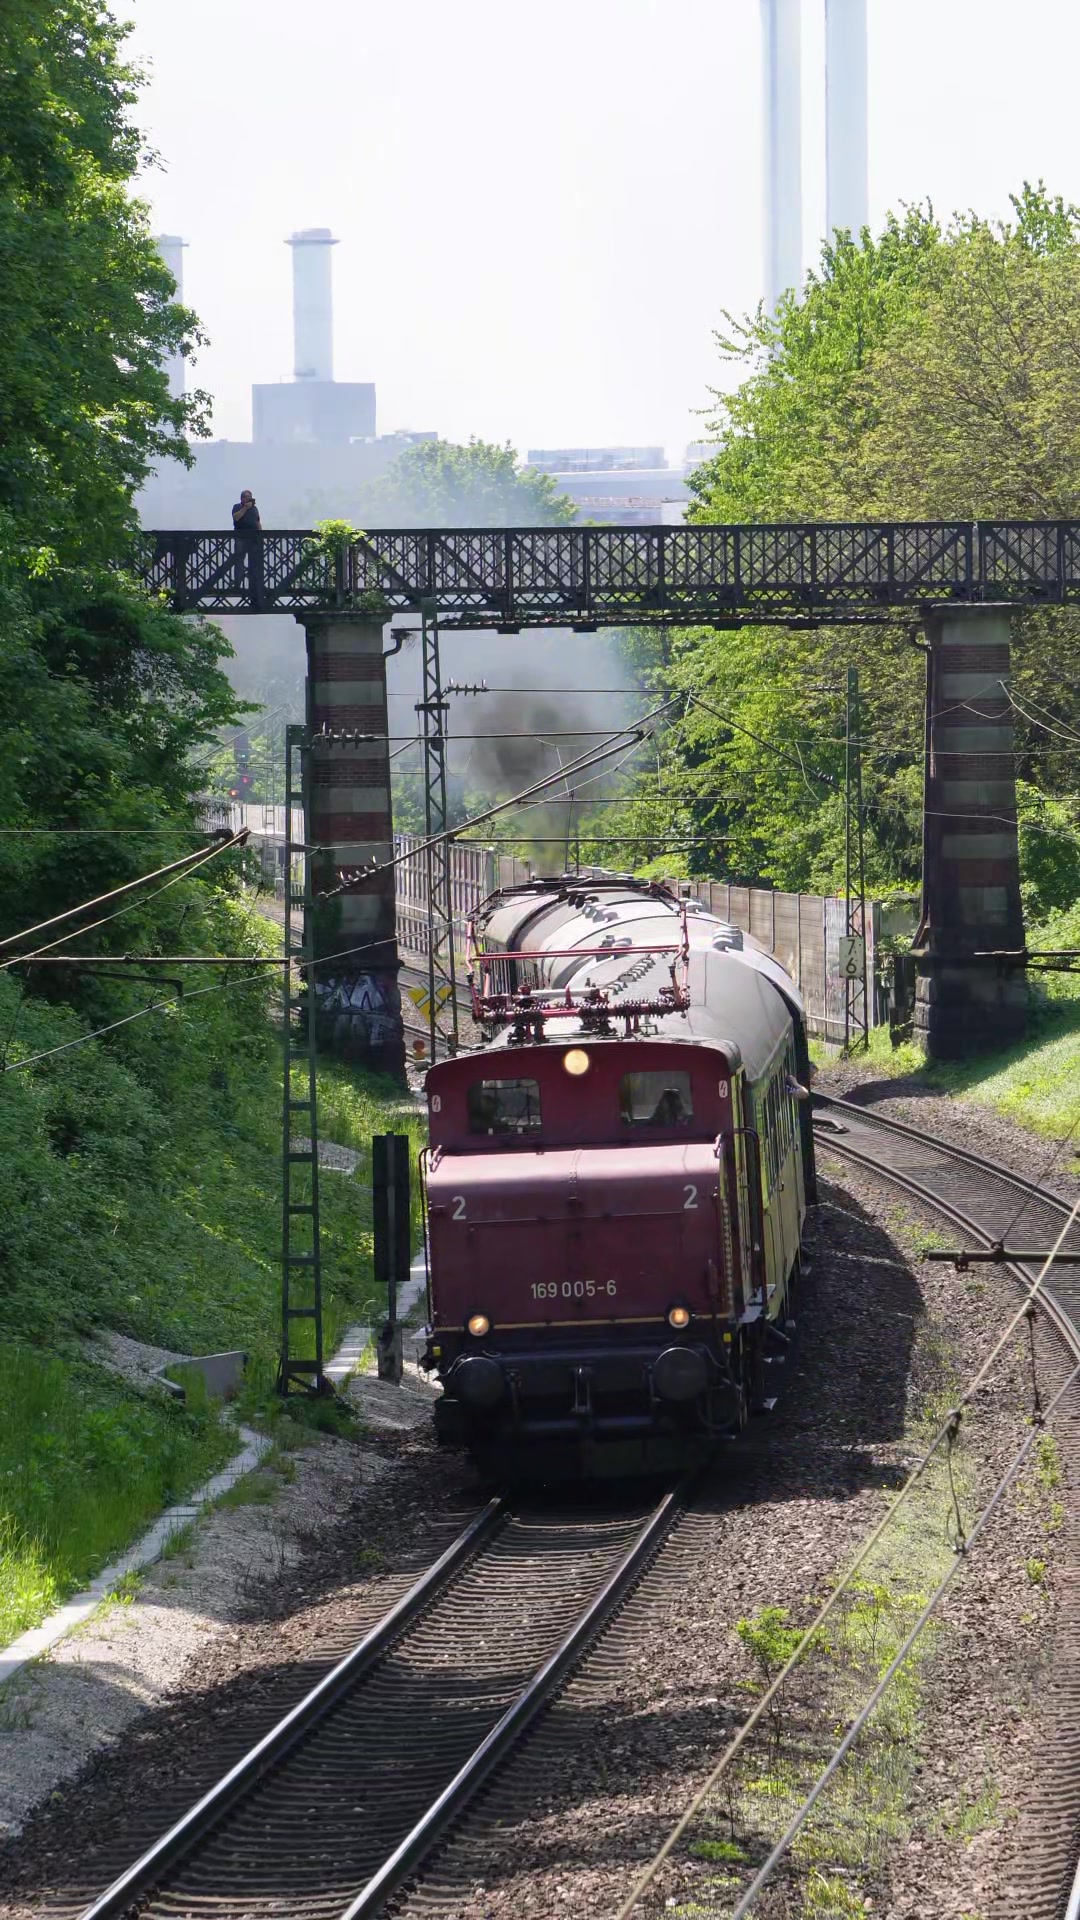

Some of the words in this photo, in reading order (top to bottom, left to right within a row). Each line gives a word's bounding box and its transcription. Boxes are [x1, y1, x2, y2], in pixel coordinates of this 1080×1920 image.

[847, 939, 856, 955] 7
[846, 957, 857, 974] 6
[683, 1184, 698, 1209] 2
[452, 1195, 467, 1220] 2
